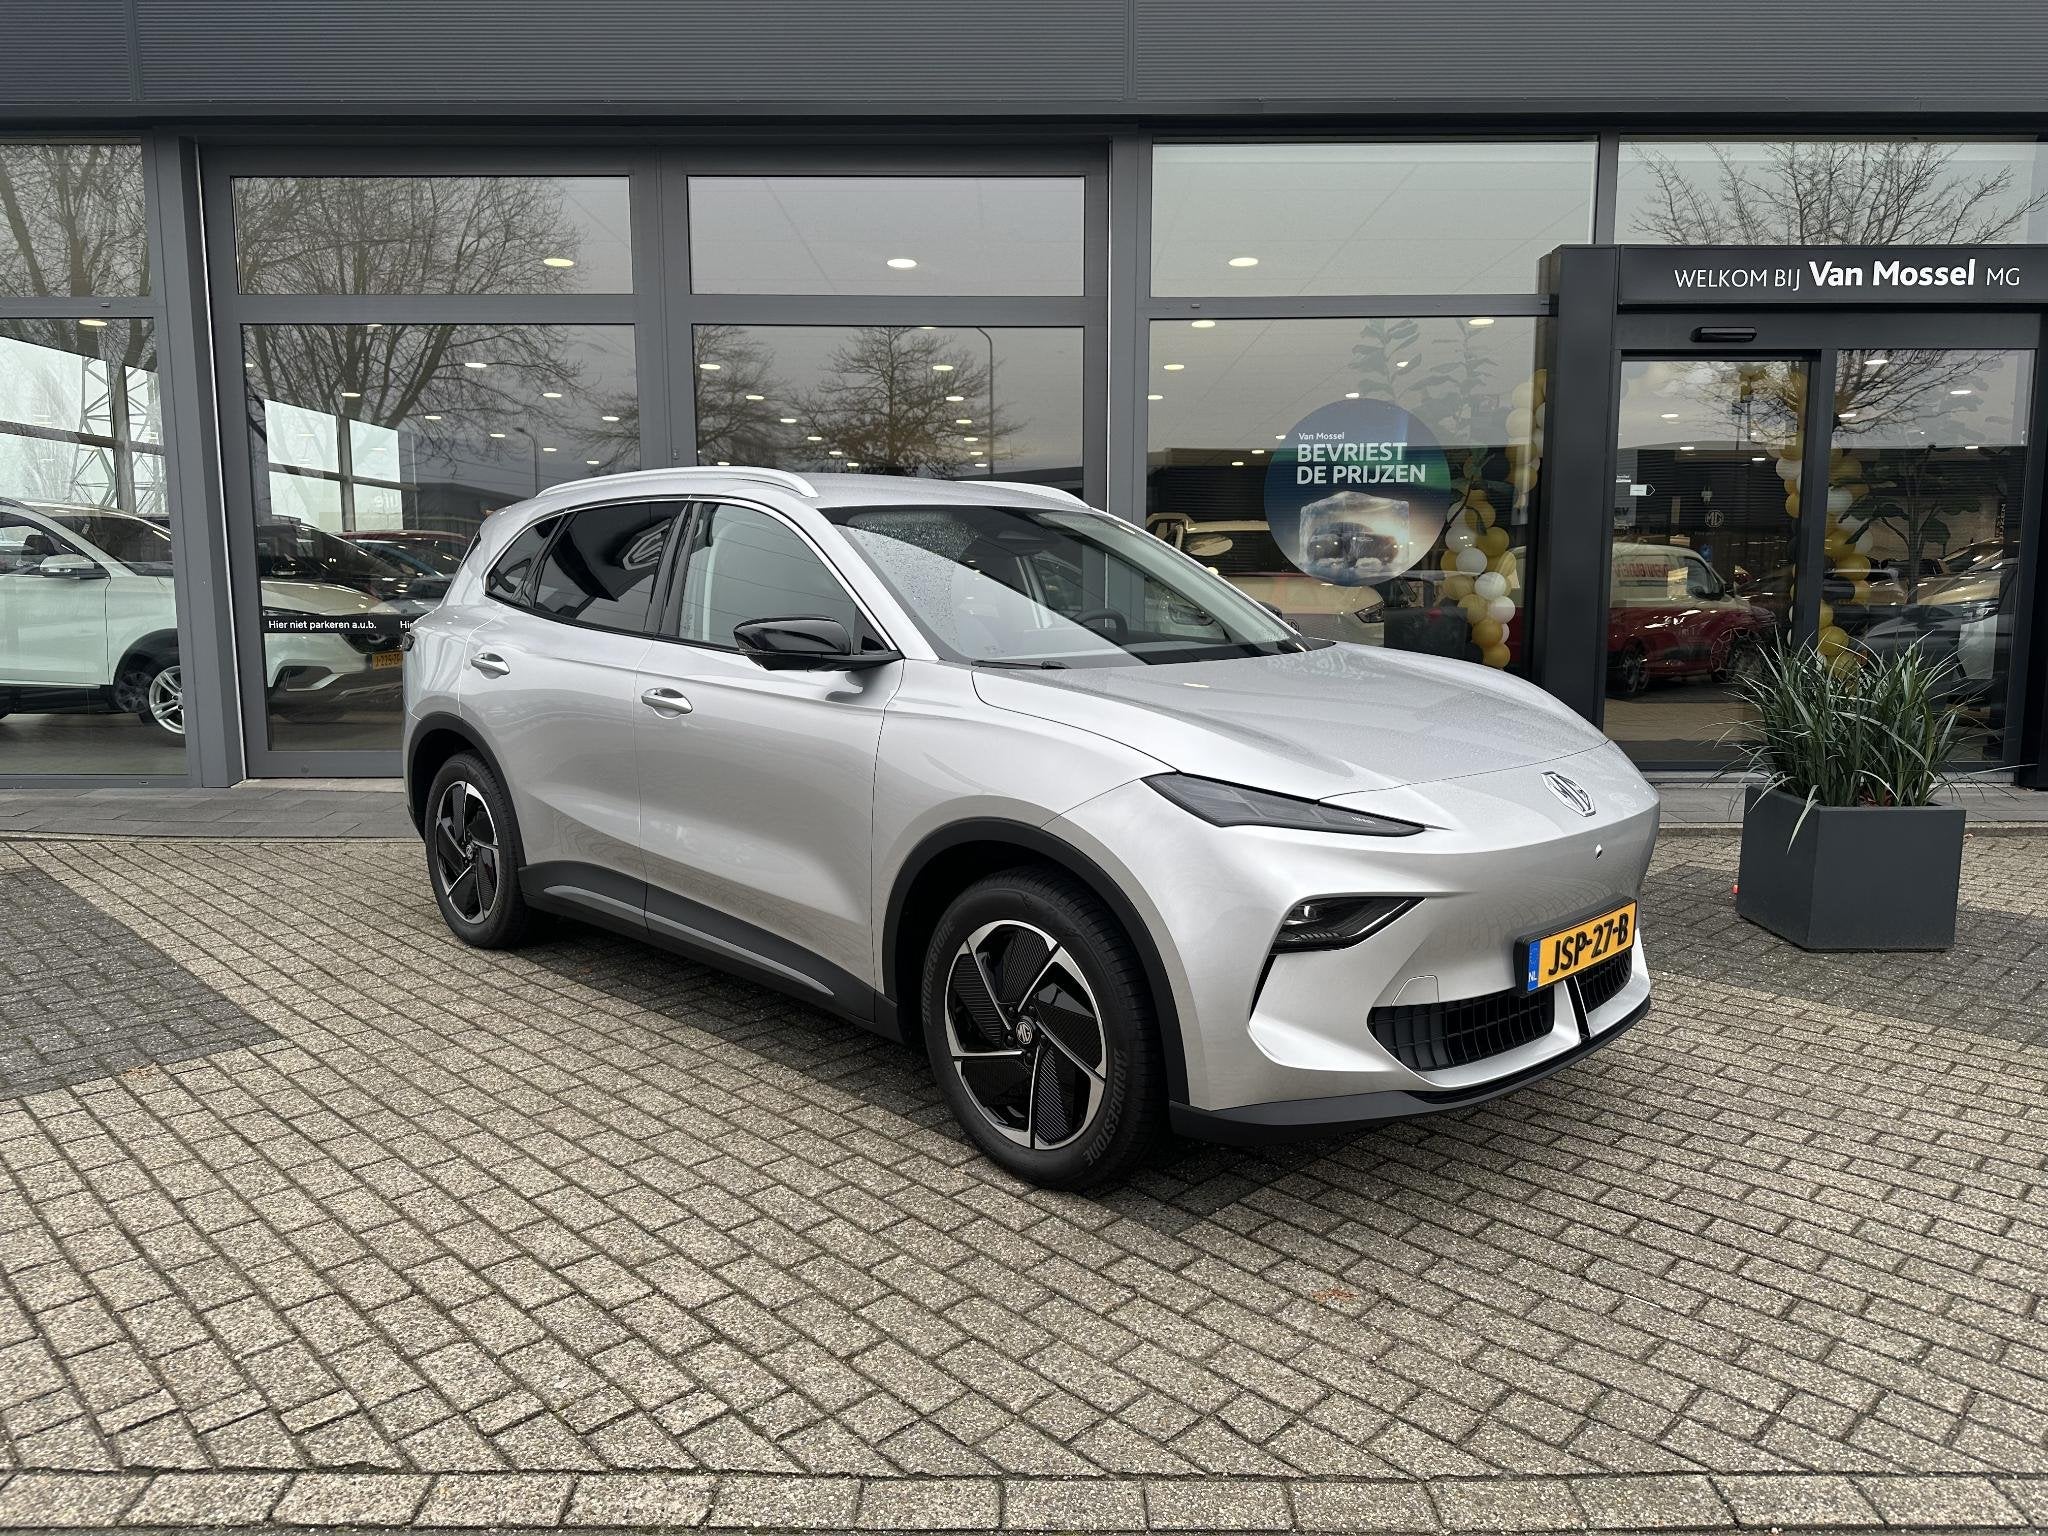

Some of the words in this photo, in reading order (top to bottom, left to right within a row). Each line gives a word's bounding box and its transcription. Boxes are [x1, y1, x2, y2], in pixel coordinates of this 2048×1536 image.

[1674, 268, 1767, 288] WELKOM
[1774, 268, 1800, 292] BIJ
[1808, 260, 1863, 287] Van
[1872, 258, 1976, 287] Mossel
[1986, 267, 2021, 286] MG
[1298, 432, 1314, 440] Van
[1316, 431, 1345, 440] Mossel
[1297, 442, 1407, 463] BEVRIEST
[1296, 466, 1327, 485] DE
[1333, 464, 1426, 484] PRIJZEN
[1706, 511, 1723, 526] MG
[268, 620, 287, 629] Hier
[290, 620, 307, 629] niet
[309, 620, 350, 631] parkeren
[352, 620, 377, 629] a.u.b.
[1548, 912, 1629, 976] JSP-27-B
[1528, 970, 1538, 983] NL
[1016, 1023, 1032, 1043] MG
[1081, 1047, 1129, 1167] BRIDGESTONE
